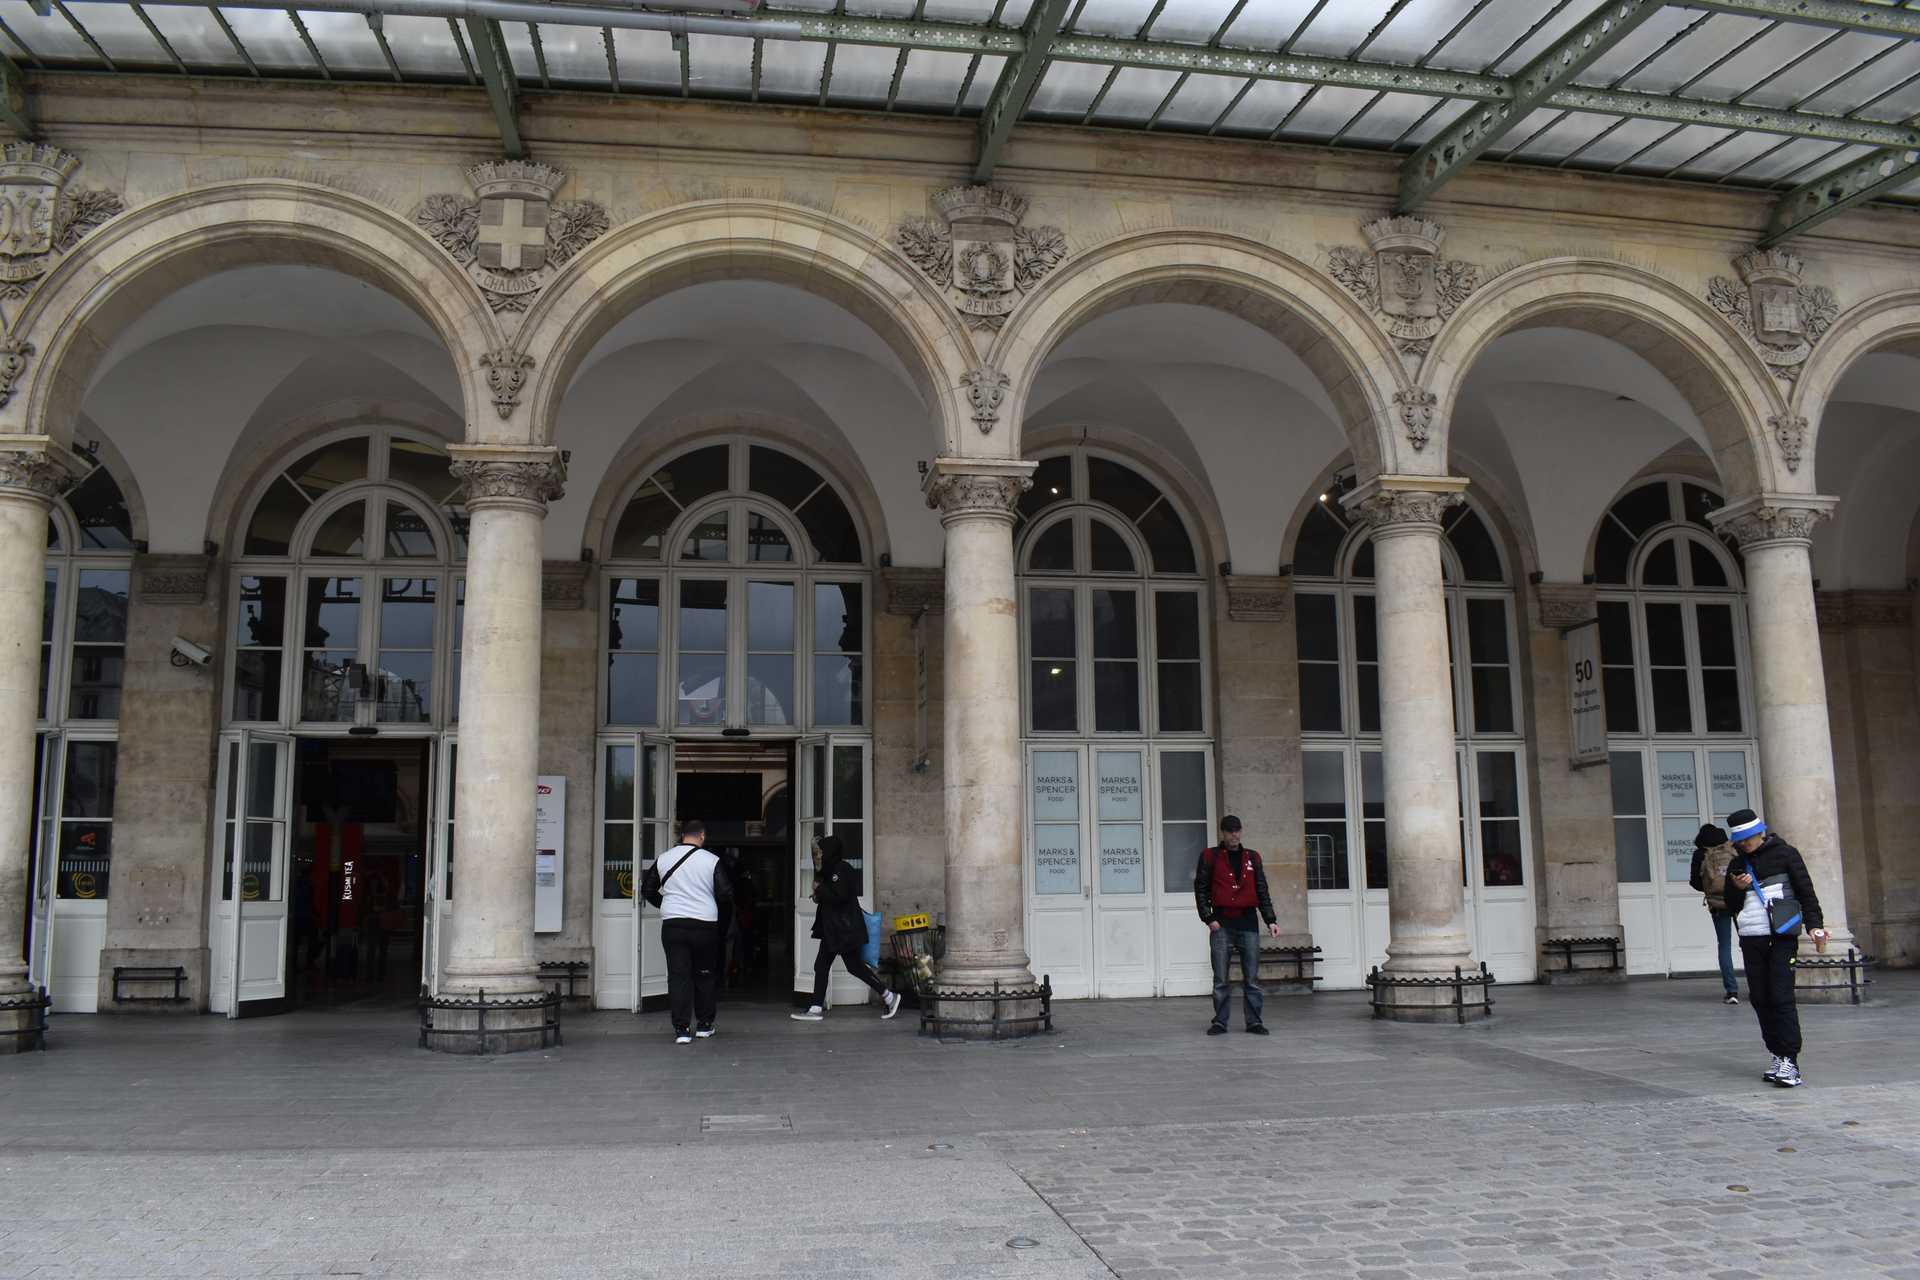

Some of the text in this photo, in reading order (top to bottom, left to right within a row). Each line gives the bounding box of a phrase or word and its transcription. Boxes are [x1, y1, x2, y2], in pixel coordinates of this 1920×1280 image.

[483, 274, 537, 292] CHALONS
[964, 297, 1002, 313] REIMS
[1575, 659, 1592, 682] 50
[1037, 776, 1065, 784] MARKS
[1035, 786, 1075, 794] SPENCER
[1100, 786, 1138, 794] SPENCER
[1038, 848, 1067, 856] MARKS
[1103, 848, 1131, 856] MARKS
[1037, 858, 1077, 866] SPENCER
[341, 860, 354, 900] KUSMI TEA
